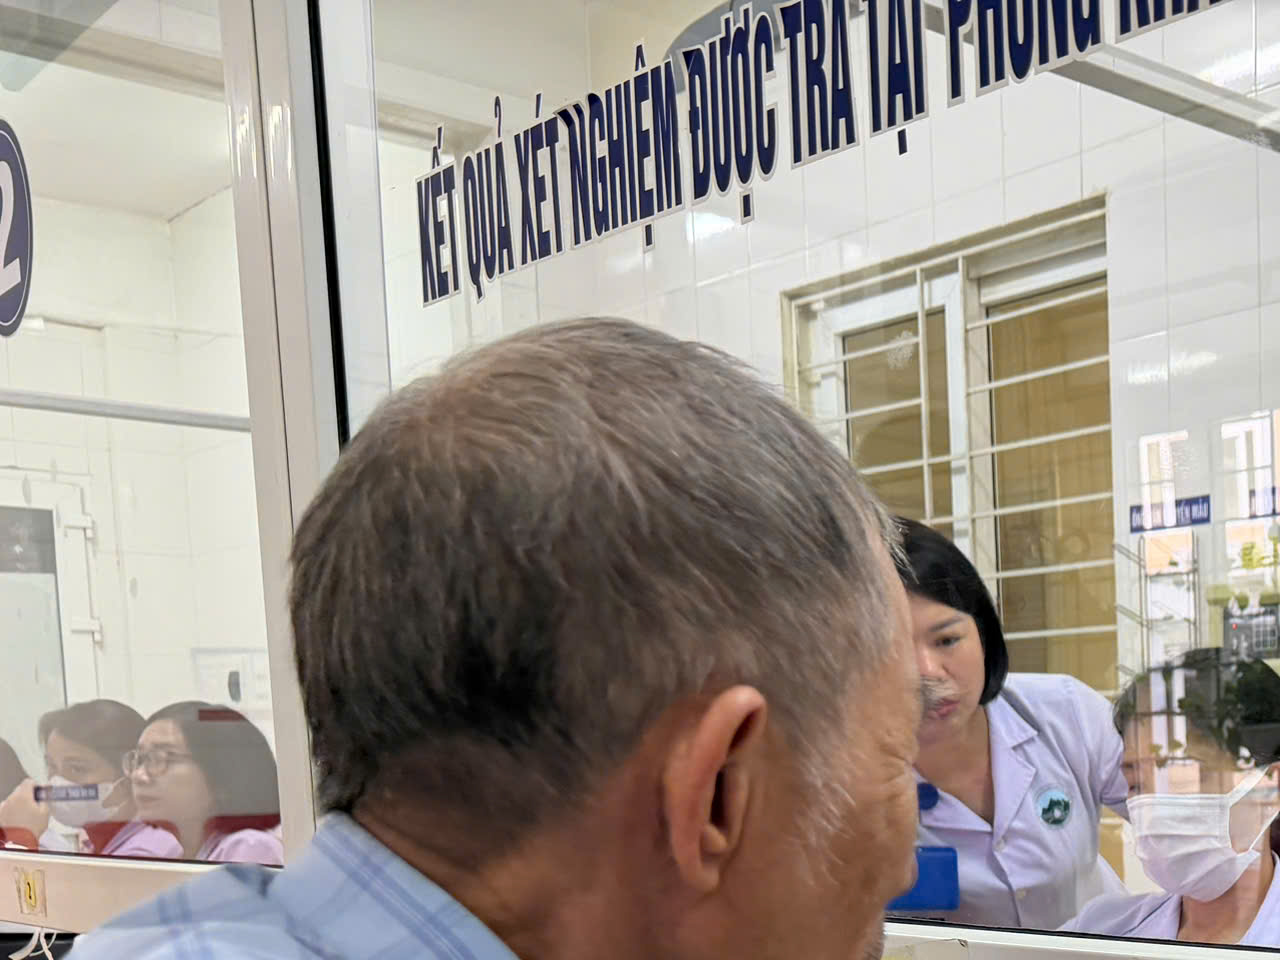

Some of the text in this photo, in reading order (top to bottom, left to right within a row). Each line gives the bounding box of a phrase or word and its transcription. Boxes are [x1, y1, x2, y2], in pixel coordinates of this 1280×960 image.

[416, 127, 460, 304] KẾT
[463, 96, 514, 300] QUẢ
[514, 93, 563, 266] XÉT
[557, 44, 683, 246] NGHIỆM
[683, 7, 775, 218] ĐƯỢC
